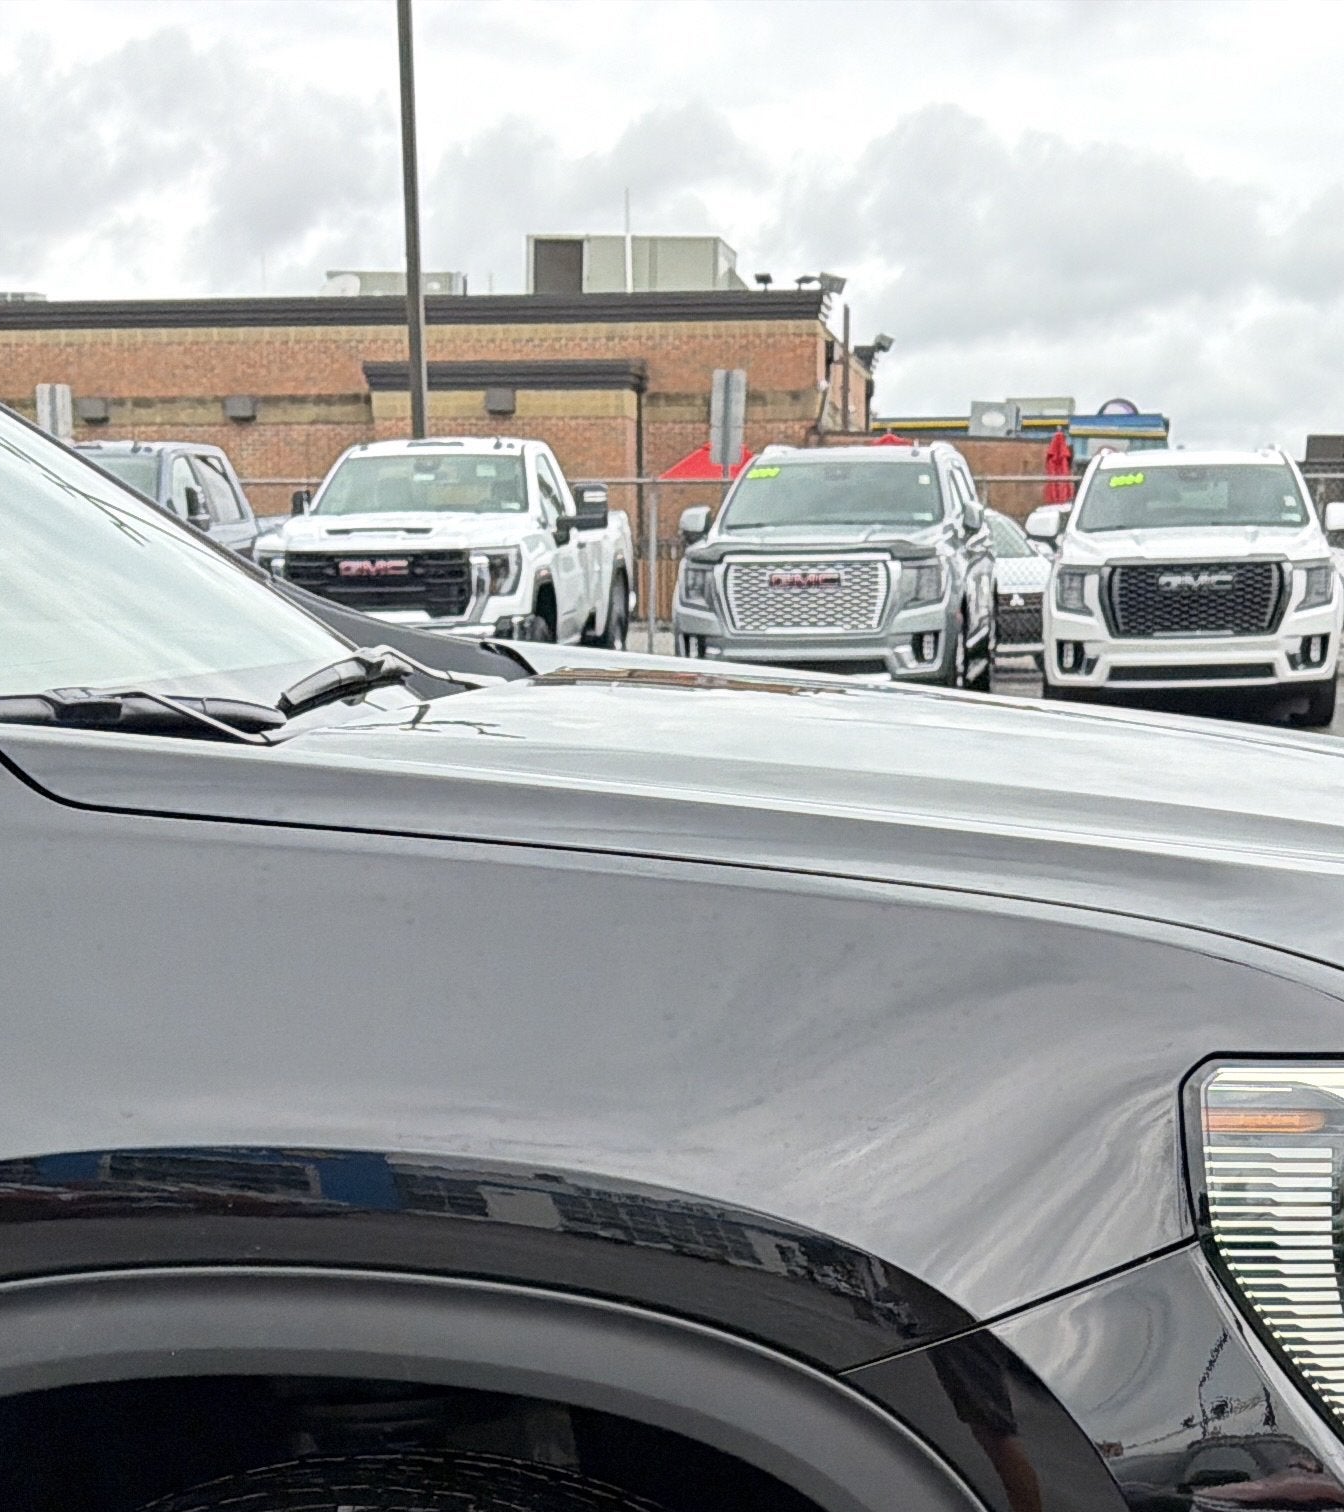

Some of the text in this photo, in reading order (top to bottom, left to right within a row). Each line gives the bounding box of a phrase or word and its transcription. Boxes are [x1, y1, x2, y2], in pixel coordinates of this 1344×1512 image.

[338, 559, 410, 577] GMC
[767, 572, 842, 589] GMC
[1158, 573, 1234, 592] GMC
